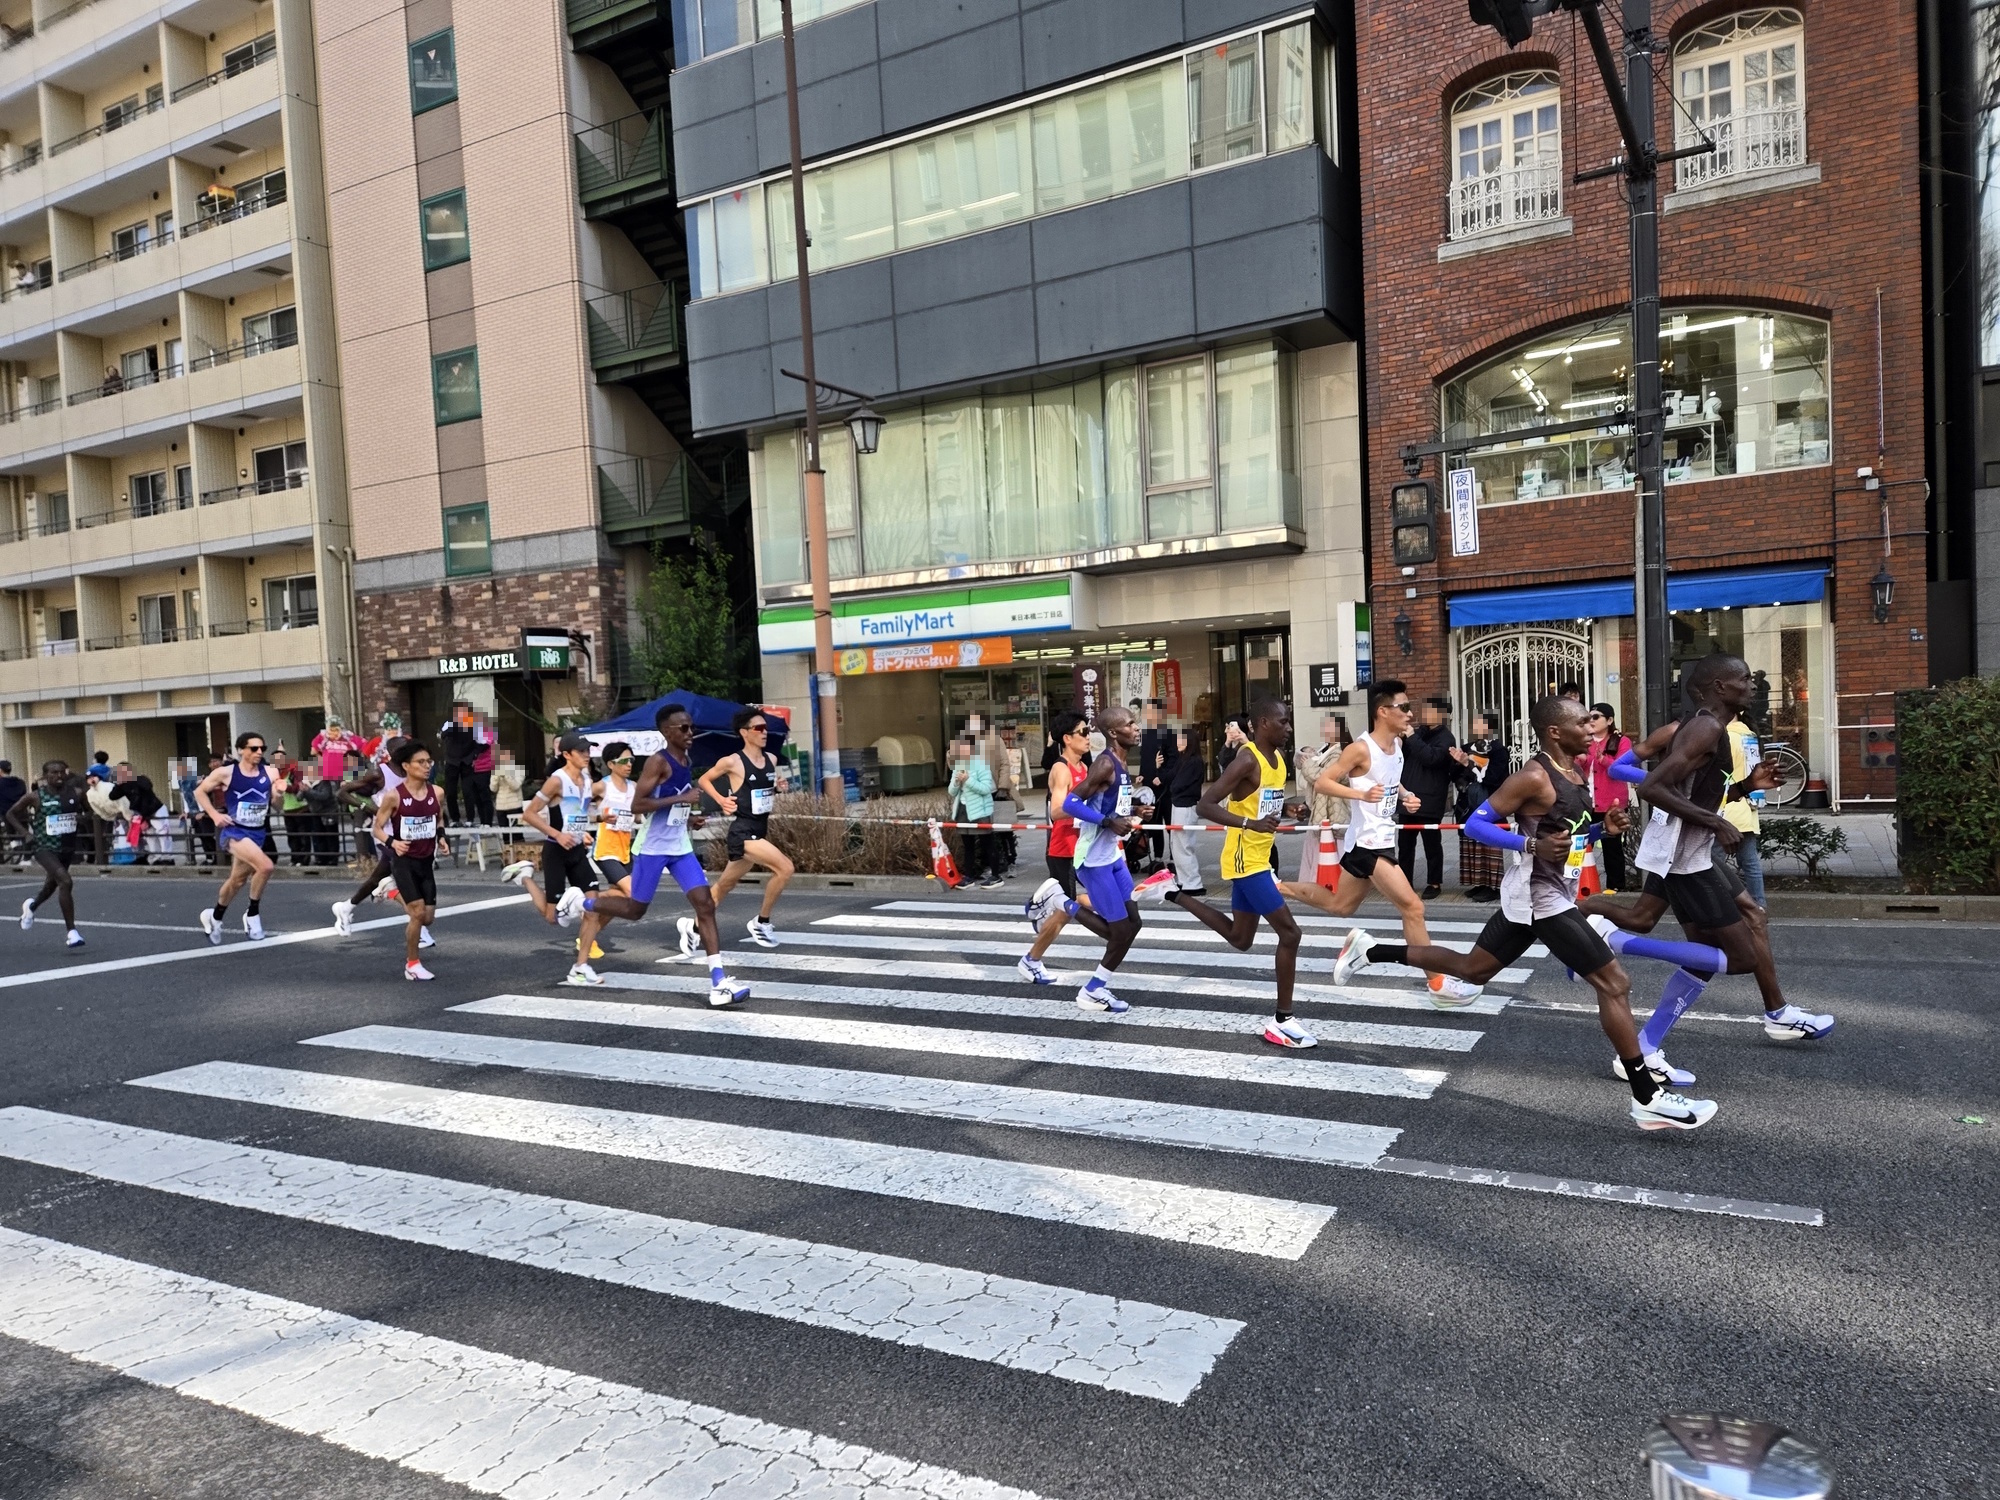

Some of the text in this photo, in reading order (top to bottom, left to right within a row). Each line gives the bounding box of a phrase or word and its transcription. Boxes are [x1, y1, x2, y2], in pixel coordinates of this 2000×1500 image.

[1455, 474, 1471, 550] 夜間押ボタン式
[860, 611, 955, 636] FamilyMart
[1010, 610, 1064, 622] 東日本橋二丁目店
[439, 652, 519, 674] R&B HOTEL
[1082, 683, 1096, 731] 中華まん
